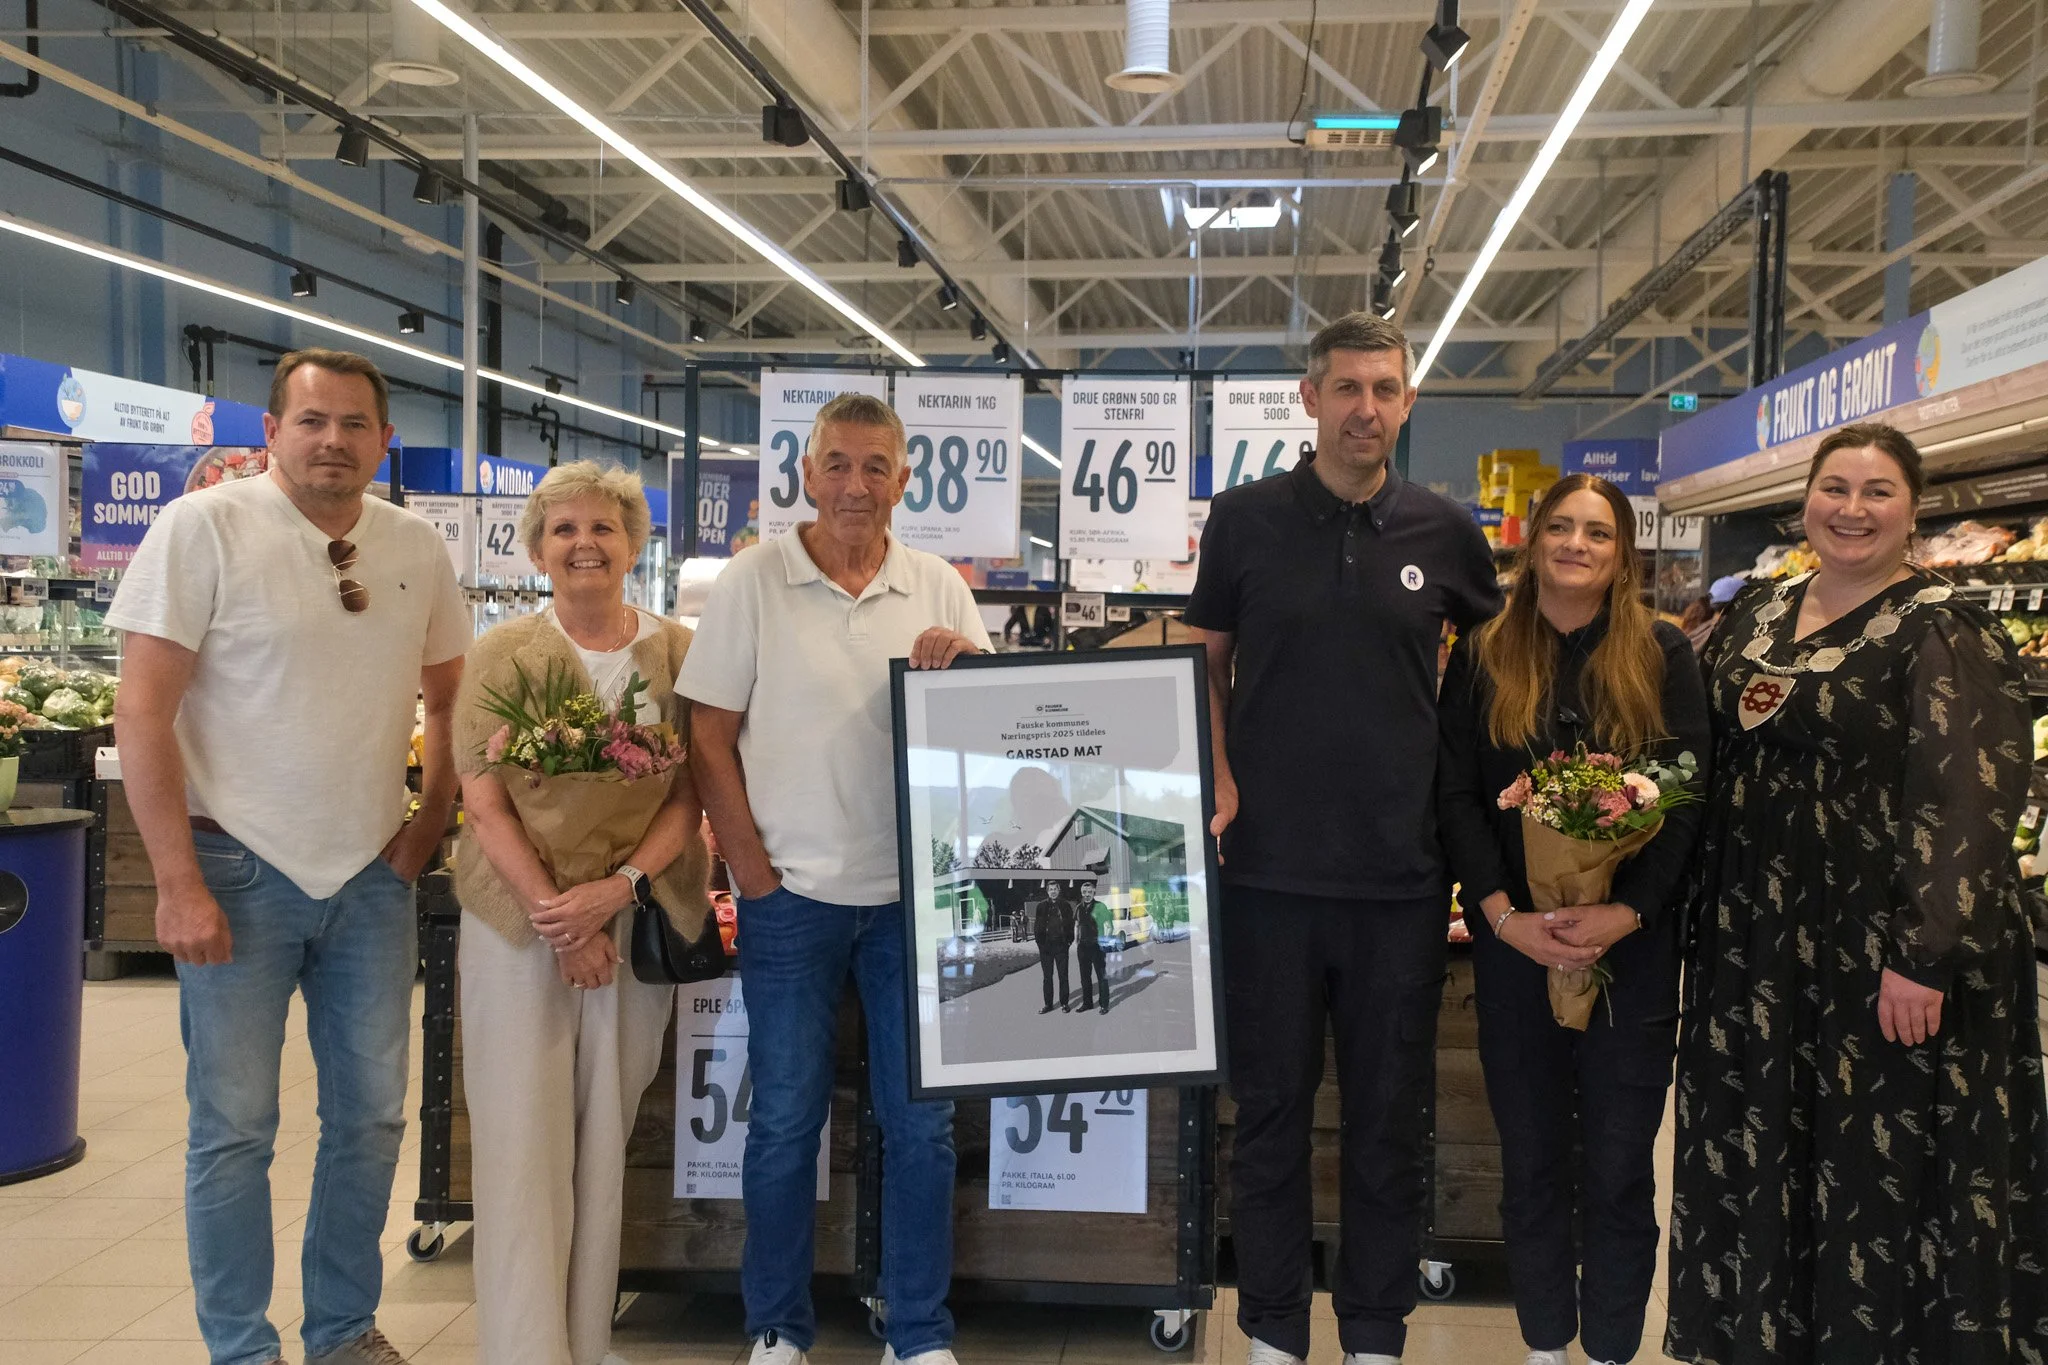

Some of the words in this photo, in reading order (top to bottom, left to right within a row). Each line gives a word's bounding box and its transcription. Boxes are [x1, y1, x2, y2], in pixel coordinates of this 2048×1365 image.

[783, 389, 836, 404] NEKTARIN
[1073, 391, 1099, 405] DRUE
[1102, 391, 1137, 405] GRØNN
[1140, 392, 1160, 405] 500
[1163, 392, 1177, 405] GR
[1229, 392, 1255, 405] DRUE
[1258, 392, 1285, 405] RØDE
[1773, 376, 1815, 444] FRUKT
[1817, 366, 1838, 430] OG
[1840, 342, 1898, 422] GRØNT
[918, 394, 971, 410] NEKTARIN
[975, 395, 996, 410] 1KG
[1104, 407, 1145, 420] STENFRI
[1263, 408, 1290, 420] 500G
[0, 454, 44, 469] ROKKOLI
[1583, 452, 1617, 466] Alltid
[769, 429, 817, 509] 3
[903, 434, 969, 514] 38
[976, 438, 1007, 475] 90
[496, 465, 534, 495] MIDDAG
[1072, 439, 1138, 515] 46
[1146, 441, 1176, 476] 90
[111, 471, 160, 501] GOD
[93, 502, 166, 526] SOMME
[445, 522, 459, 538] 90
[1638, 511, 1654, 536] 19
[486, 523, 516, 556] 42
[97, 550, 123, 562] ALLTID
[1081, 604, 1096, 621] 46
[1016, 721, 1044, 731] Fauske
[1046, 719, 1089, 729] kommunes
[1001, 732, 1051, 742] Næringspris
[1053, 730, 1074, 738] 2025
[1076, 728, 1106, 737] tildeles
[1006, 747, 1069, 760] GARSTAD
[1074, 745, 1102, 757] MAT
[693, 998, 722, 1014] EPLE
[687, 1161, 713, 1170] PAKKE,
[715, 1162, 740, 1170] ITALIA,
[686, 1170, 699, 1178] PR.
[1002, 1171, 1028, 1180] PAKKE,
[1030, 1173, 1055, 1181] ITALIA,
[1056, 1173, 1076, 1181] 61.00
[1002, 1181, 1014, 1189] PR.
[1015, 1182, 1055, 1190] KILOGRAM
